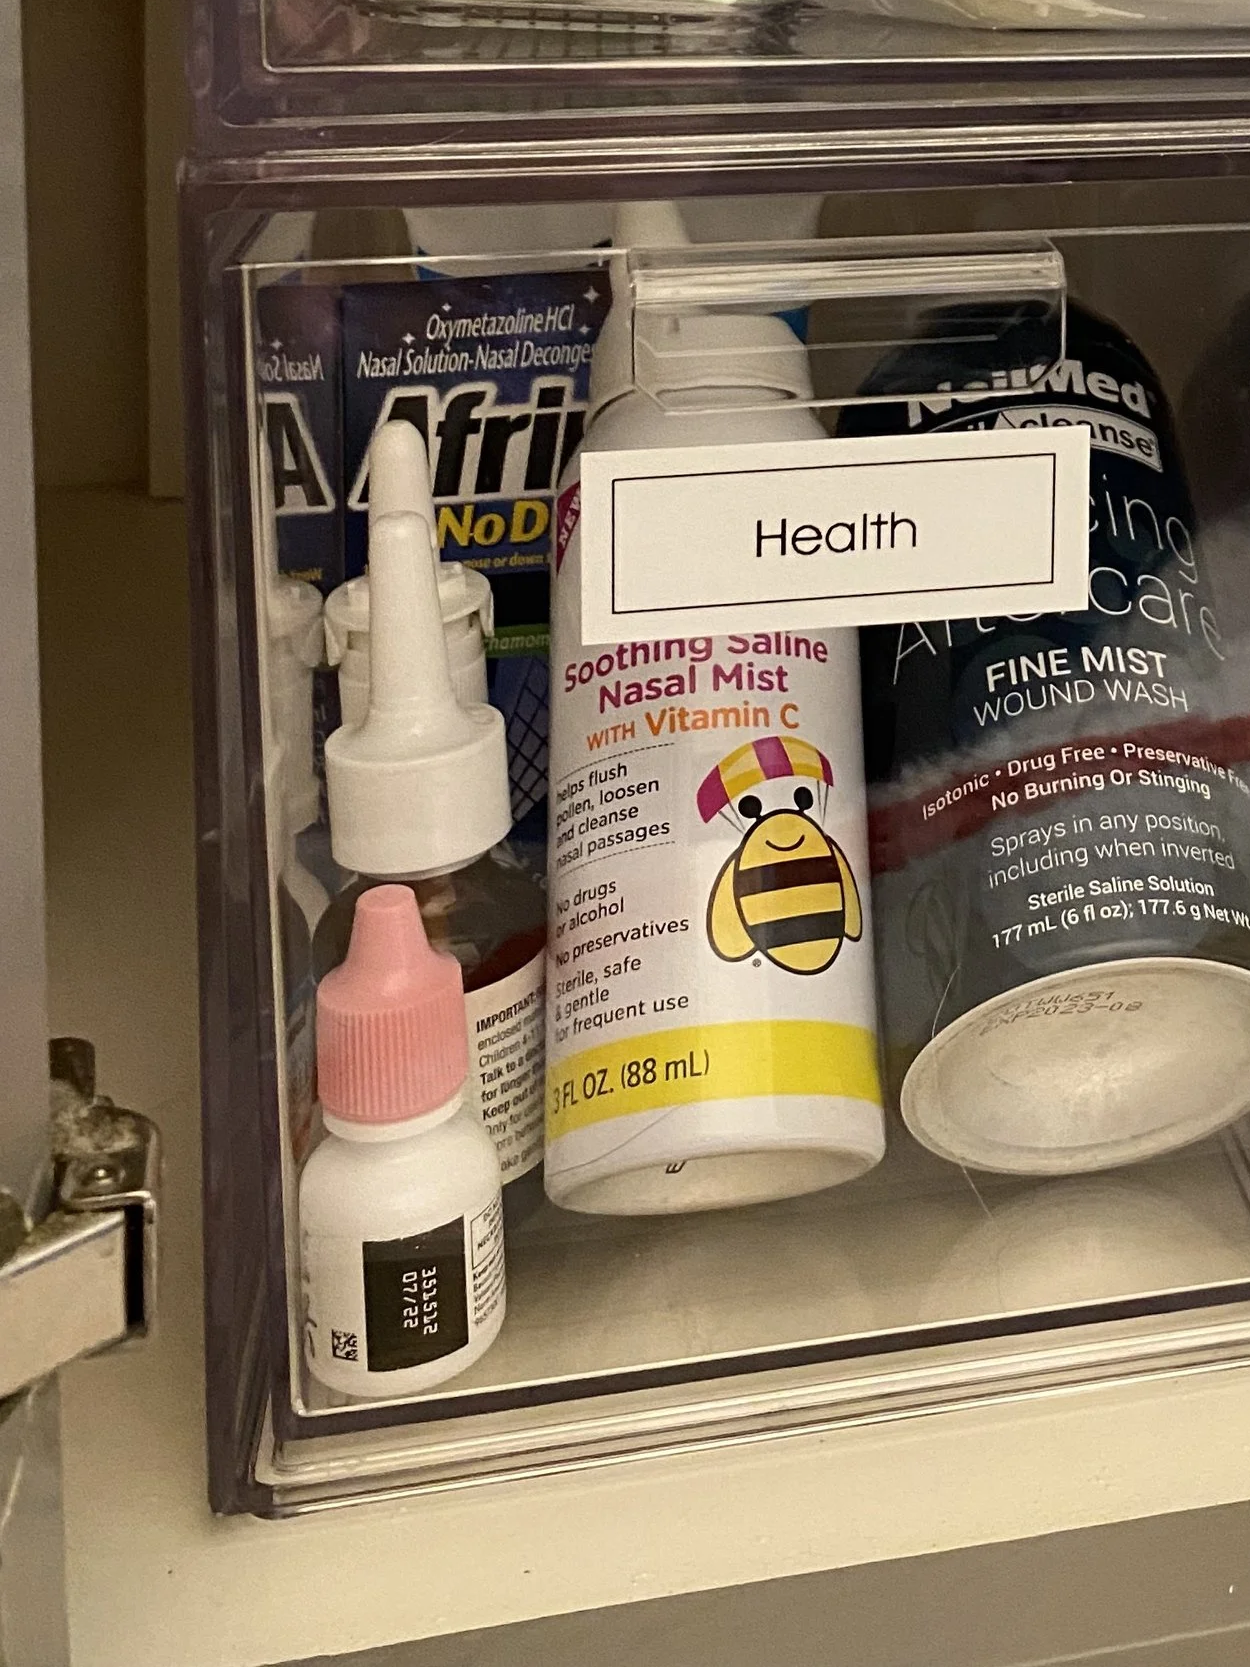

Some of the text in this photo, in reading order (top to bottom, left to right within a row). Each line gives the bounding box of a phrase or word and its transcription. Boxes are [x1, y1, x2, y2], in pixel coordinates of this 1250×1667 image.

[426, 307, 543, 352] Oxymetazoline
[357, 347, 401, 380] Nasal
[436, 503, 507, 550] No
[754, 510, 918, 558] Health
[564, 631, 829, 692] Soothing Saline
[985, 645, 1167, 693] FINE MIST
[599, 661, 789, 714] Nasal Mist
[973, 678, 1190, 727] WOUND WASH
[586, 700, 800, 751] WITH Vitamin C
[588, 762, 628, 788] flush
[922, 772, 991, 821] Isotonic
[1007, 751, 1057, 778] Drug
[1061, 744, 1107, 765] Free
[1123, 742, 1227, 781] Preservative
[990, 767, 1212, 812] No Burning Or Stinging
[556, 779, 660, 829] pollen, loosen
[577, 805, 639, 836] cleanse
[586, 821, 671, 857] passages
[990, 819, 1067, 858] Sprays
[1072, 814, 1094, 835] in
[1098, 811, 1139, 834] any
[988, 838, 1236, 890] including when inverted
[569, 895, 625, 931] alcohol
[573, 880, 617, 908] drugs
[1027, 875, 1216, 912] Sterile Saline Solution
[572, 917, 690, 964] preservatives
[991, 923, 1024, 950] 177
[1027, 914, 1058, 937] mL
[1060, 905, 1081, 931] (6
[1083, 901, 1097, 922] fl
[1138, 898, 1188, 917] 177.6
[1190, 902, 1202, 922] g
[1204, 903, 1231, 925] Net
[602, 954, 643, 980] safe
[564, 986, 611, 1020] gentle
[573, 999, 647, 1036] frequent
[652, 994, 690, 1014] use
[479, 1040, 522, 1068] Children
[479, 1066, 505, 1086] Talk
[553, 1085, 561, 1115] 3
[562, 1081, 579, 1107] FL
[582, 1067, 615, 1100] OZ.
[620, 1056, 658, 1091] (88
[664, 1048, 711, 1081] mL)
[482, 1099, 511, 1121] Keep
[401, 1271, 419, 1329] 07/22
